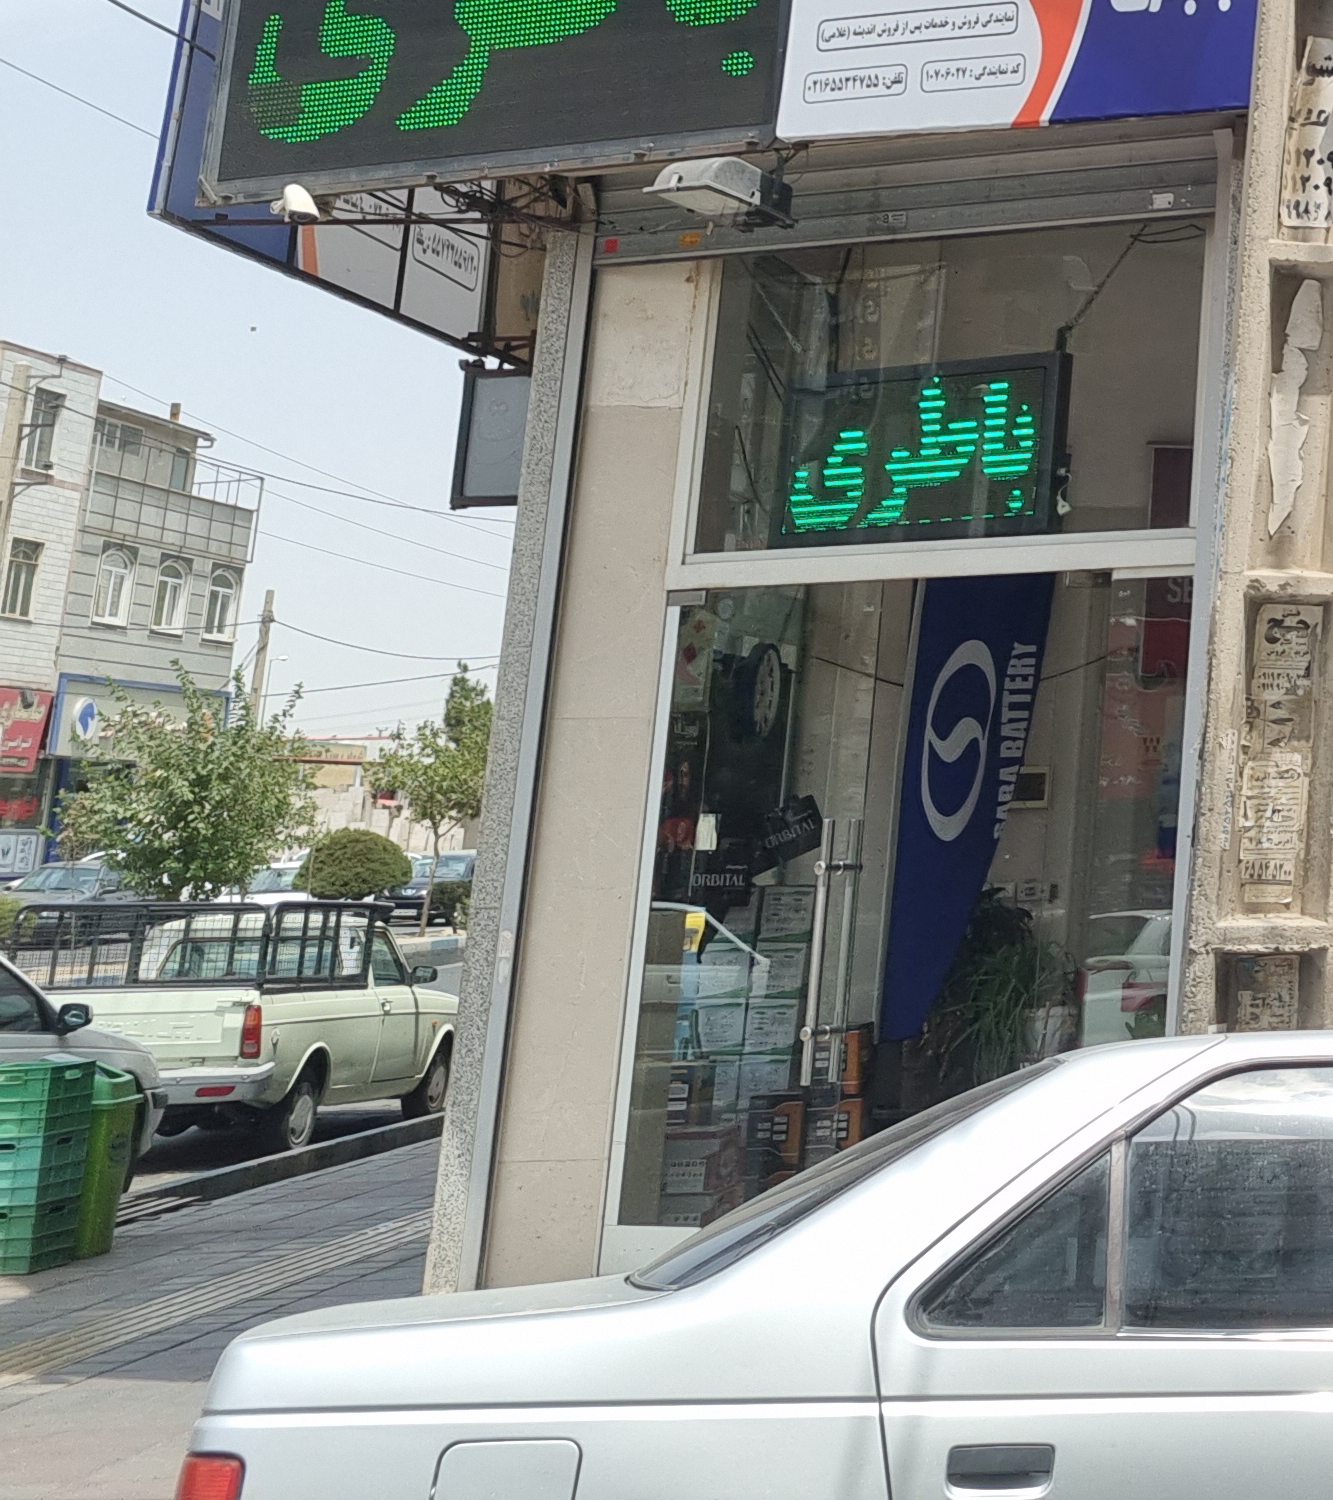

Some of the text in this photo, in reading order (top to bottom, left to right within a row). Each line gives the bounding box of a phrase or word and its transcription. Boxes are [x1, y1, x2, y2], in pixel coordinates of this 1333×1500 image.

[900, 19, 909, 37] از
[909, 21, 922, 36] پس
[923, 17, 950, 33] خدمات
[950, 20, 958, 32] و
[956, 12, 981, 35] فروش
[981, 10, 1016, 31] نمایندگی
[852, 22, 876, 40] اندیشه
[876, 21, 899, 40] فروش
[974, 63, 1008, 83] نمایندگی
[1008, 62, 1022, 77] کد
[789, 377, 1036, 532] باطری
[1000, 640, 1038, 760] BATTERY
[692, 873, 746, 888] ORBITAL
